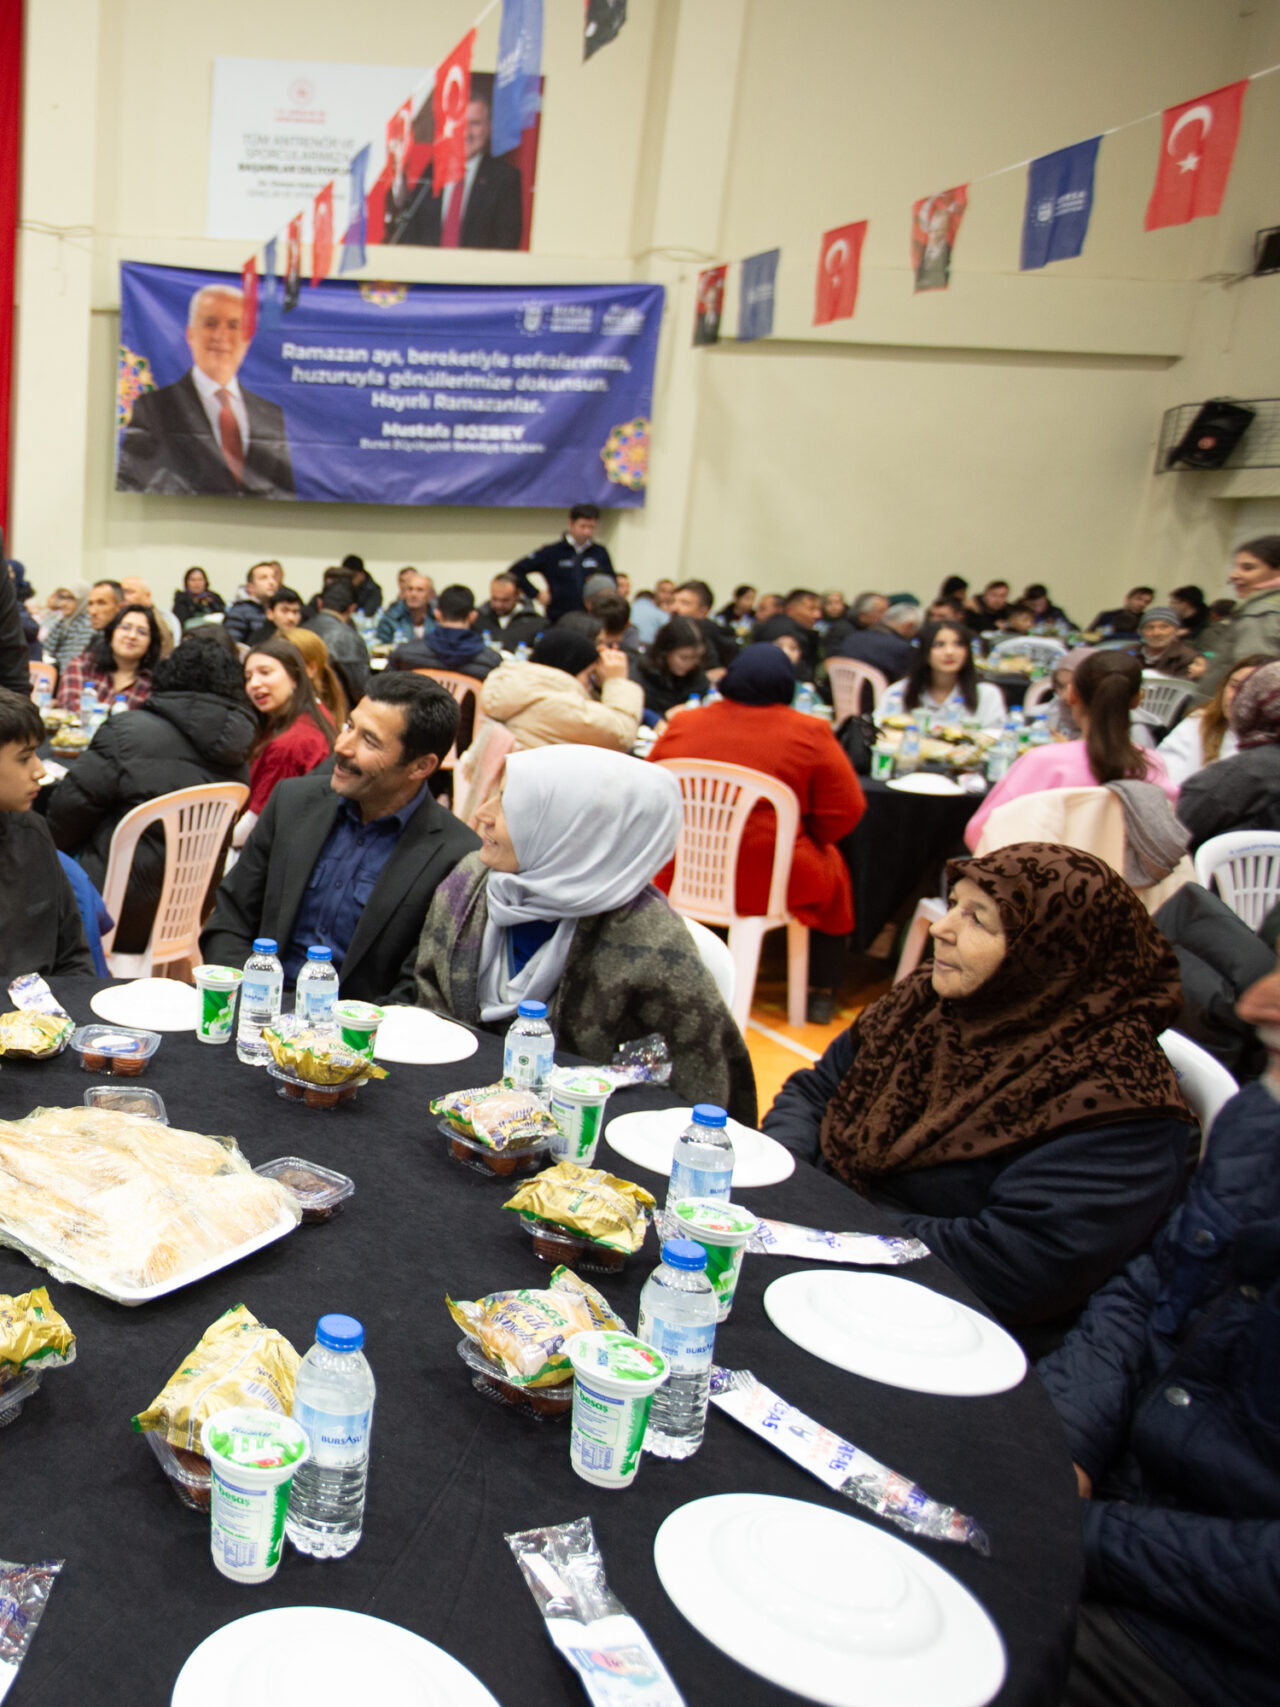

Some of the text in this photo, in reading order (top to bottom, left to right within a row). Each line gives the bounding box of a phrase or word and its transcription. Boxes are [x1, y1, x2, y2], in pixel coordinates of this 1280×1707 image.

[281, 341, 369, 363] Ramazan
[407, 346, 510, 371] bereketiyle
[291, 364, 386, 389] huzuruyla
[388, 369, 513, 391] gönüllerimize
